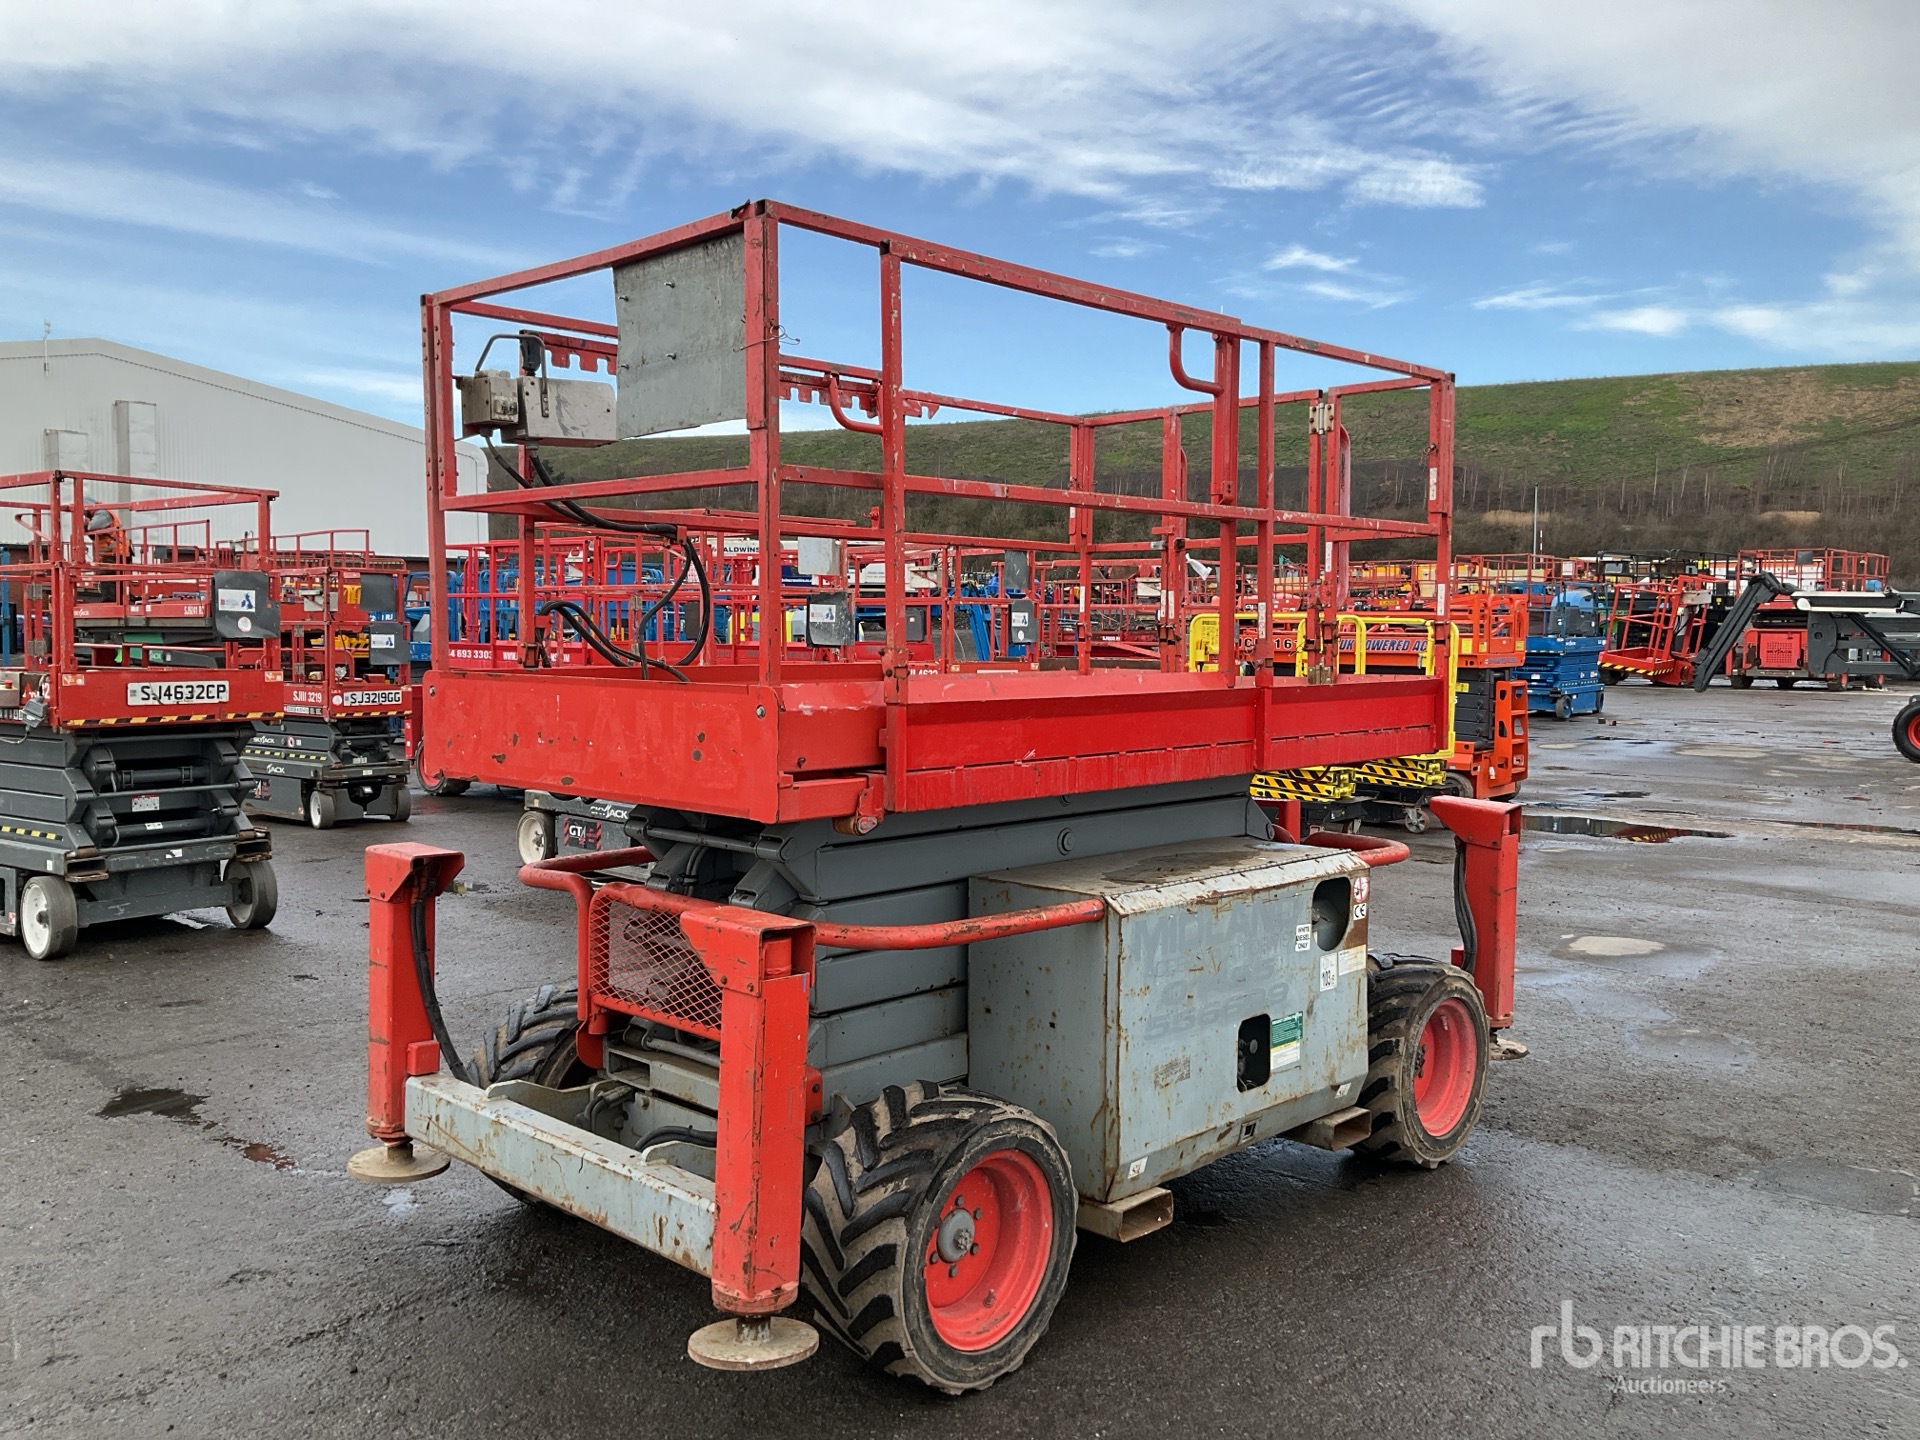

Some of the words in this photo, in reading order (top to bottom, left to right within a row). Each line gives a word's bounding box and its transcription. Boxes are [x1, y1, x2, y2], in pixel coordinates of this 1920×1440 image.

[1365, 639, 1410, 651] OWERED
[456, 650, 472, 659] 693
[140, 684, 227, 702] SJ4632CP
[307, 691, 322, 703] 3219
[350, 692, 401, 704] SJ3219GG
[1354, 903, 1366, 919] CE
